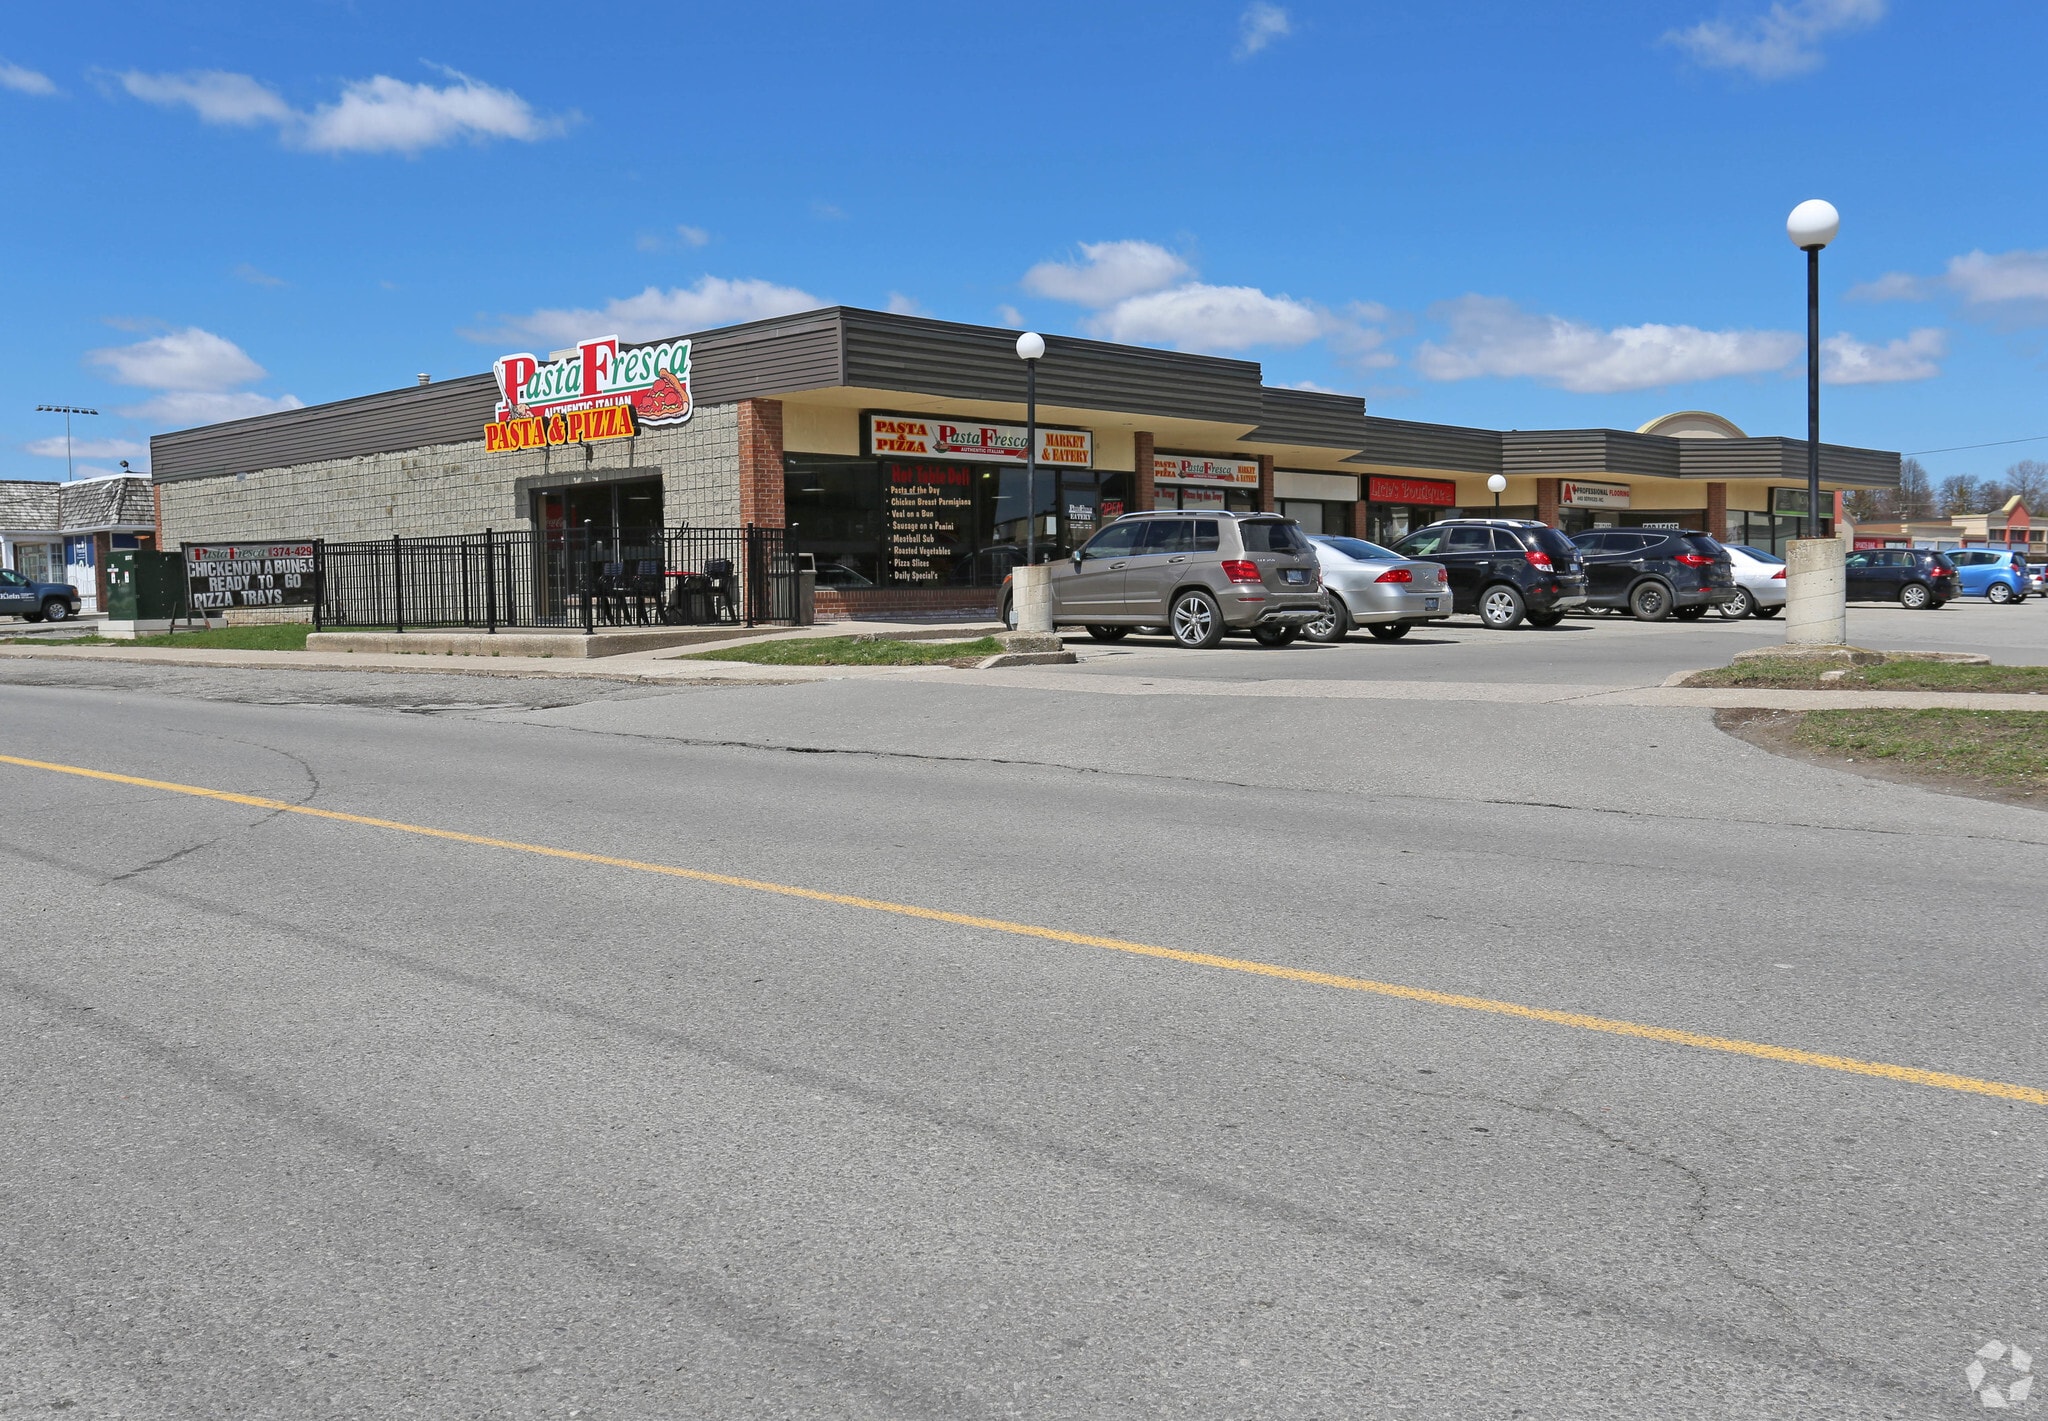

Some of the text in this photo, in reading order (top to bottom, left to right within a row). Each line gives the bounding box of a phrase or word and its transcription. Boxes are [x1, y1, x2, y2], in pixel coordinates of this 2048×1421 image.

[544, 394, 632, 418] AUTHENTIC ITALIAN
[486, 407, 632, 451] PASTA & PIZZA
[874, 420, 928, 436] PASTA
[898, 433, 907, 441] &
[1046, 433, 1086, 448] MARKET
[876, 438, 927, 453] PIZZA
[1042, 449, 1089, 463] & EATERY
[1154, 460, 1176, 469] PASTA
[892, 466, 970, 486] Hot Table Deli
[1155, 470, 1176, 478] PIZZA
[890, 486, 940, 496] Pasta of the Day
[1401, 481, 1446, 504] Boutique
[1576, 486, 1630, 498] PROFESSIONAL FLOORING
[891, 498, 971, 507] Chicken Breast Parmigiana
[1101, 502, 1124, 516] OPEN
[891, 510, 905, 518] Veal
[921, 510, 934, 518] Bun
[892, 521, 918, 532] Sausage
[934, 521, 954, 531] Panini
[893, 534, 935, 543] Meatball Sub
[894, 546, 951, 557] Roasted Vegetables
[188, 560, 242, 578] CHICKEN
[242, 560, 261, 576] ON
[264, 559, 274, 575] A
[274, 558, 300, 574] BUN
[894, 558, 930, 567] Pizza Slices
[208, 573, 302, 592] READY TO GO
[894, 571, 938, 582] Daily Special's
[193, 588, 283, 609] PIZZA TRAYS
